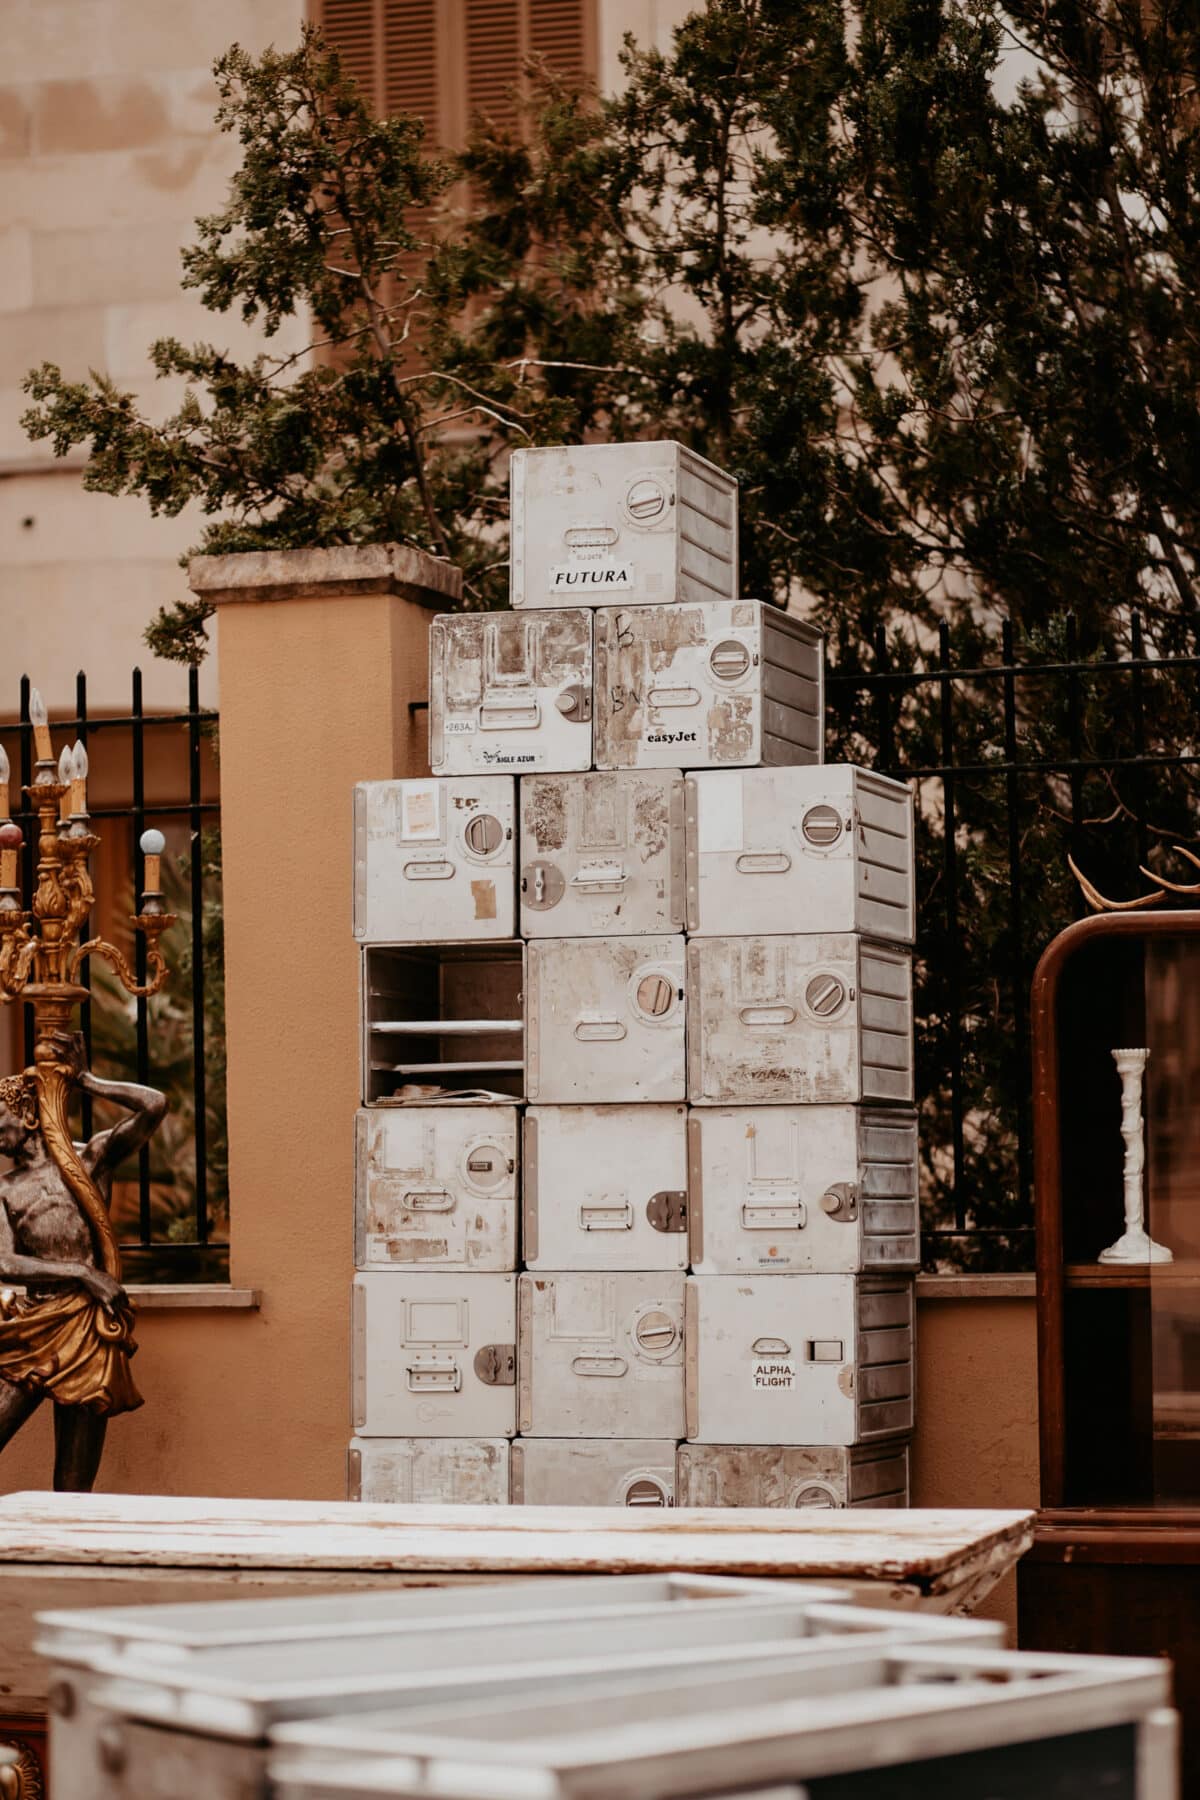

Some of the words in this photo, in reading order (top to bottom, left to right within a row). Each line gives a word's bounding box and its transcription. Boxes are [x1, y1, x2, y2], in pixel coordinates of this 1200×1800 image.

[555, 569, 628, 585] FUTURA
[647, 731, 697, 744] easyJet
[517, 755, 536, 763] AZUR
[756, 1365, 792, 1375] ALPHA
[755, 1377, 793, 1387] FLIGHT
